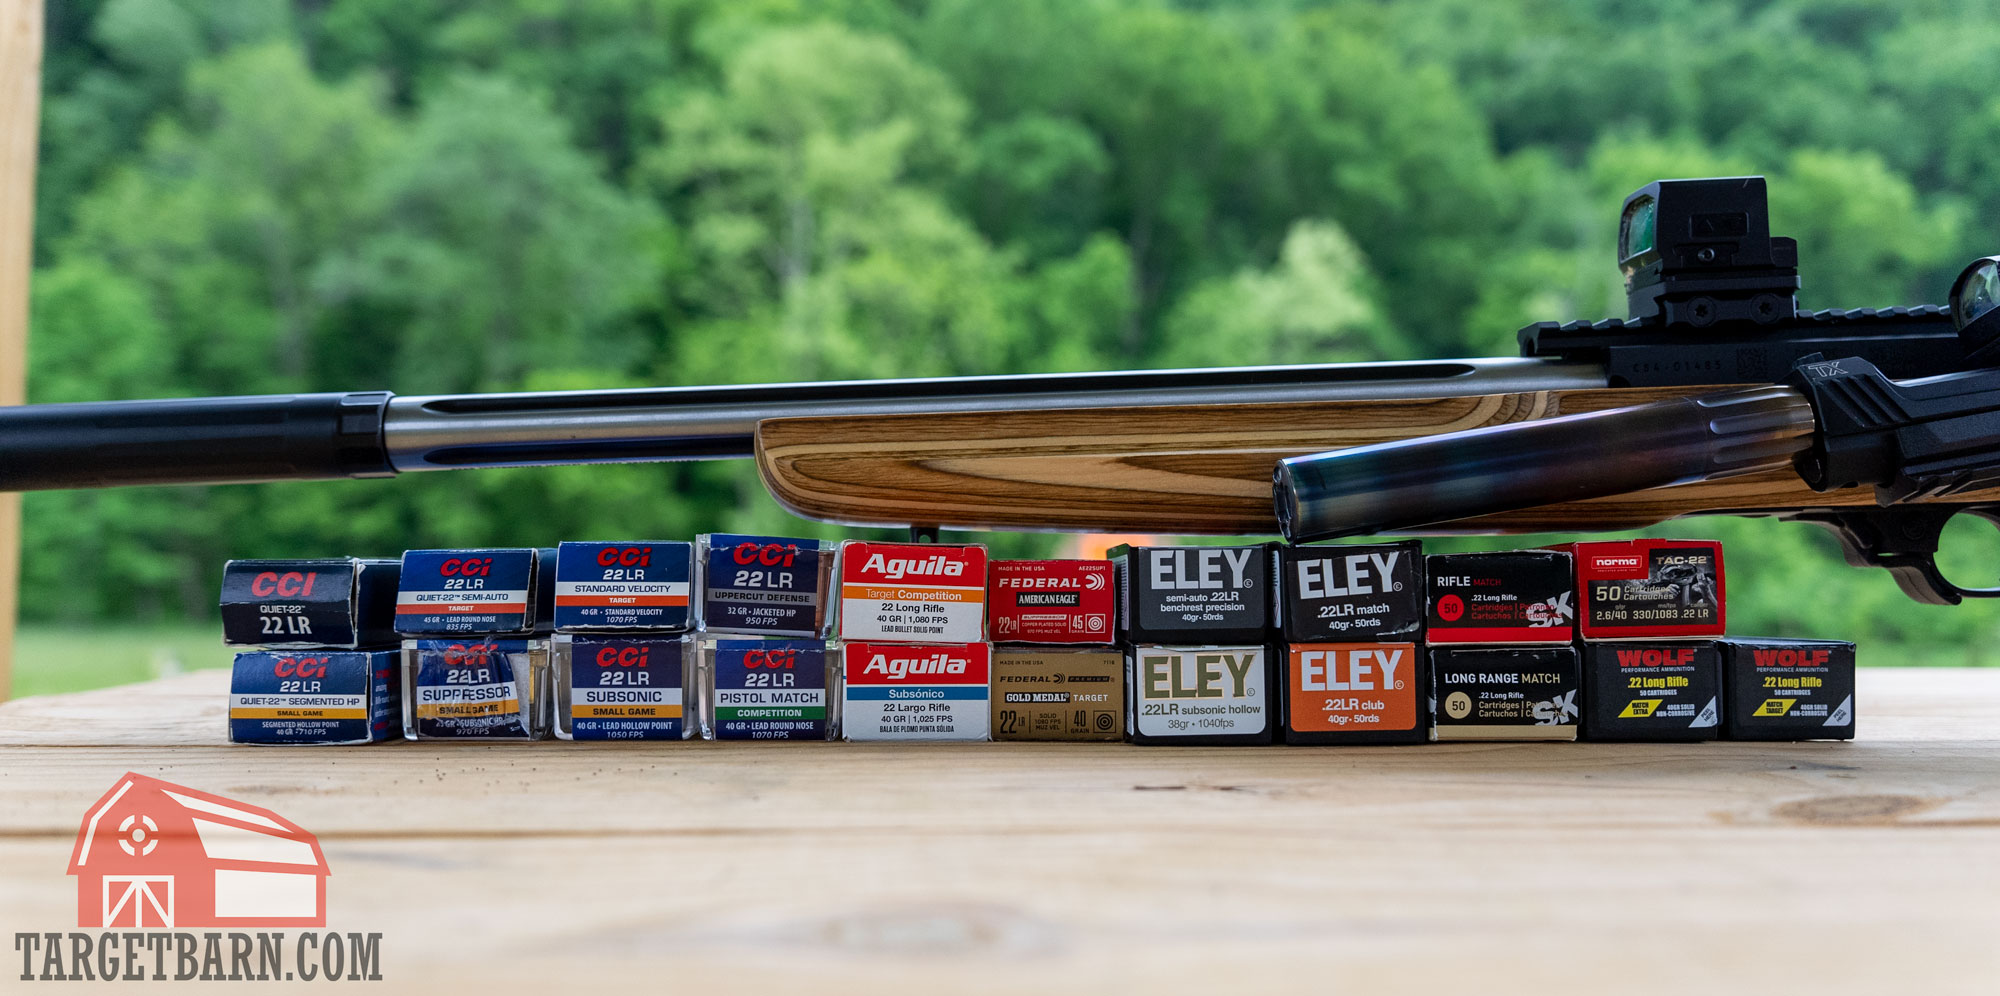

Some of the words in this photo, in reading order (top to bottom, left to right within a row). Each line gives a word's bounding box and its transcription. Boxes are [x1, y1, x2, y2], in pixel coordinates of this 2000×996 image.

[861, 554, 964, 579] Aguila
[603, 569, 624, 580] 22
[626, 570, 644, 580] LR
[734, 570, 764, 587] 22
[767, 572, 793, 589] LR
[252, 572, 317, 597] CCI
[444, 579, 464, 590] 22
[466, 579, 483, 589] LR
[999, 578, 1081, 588] FEDERAL
[1437, 576, 1471, 587] RIFLE
[575, 585, 625, 593] STANDARD
[1596, 586, 1621, 601] 50
[715, 592, 764, 601] UPPERCUT
[767, 594, 810, 602] DEFENSE
[866, 589, 895, 600] Target
[898, 590, 962, 601] Competition
[1019, 595, 1056, 604] AMERICAN
[1056, 595, 1076, 604] EAGLE
[1166, 594, 1208, 602] semi-auto
[1210, 591, 1239, 601] .22LR
[882, 603, 893, 611] 22
[896, 604, 920, 614] Long
[923, 604, 945, 613] Rifle
[1161, 604, 1203, 612] benchrest
[1206, 604, 1245, 614] precision
[1318, 604, 1354, 618] .22LR
[1357, 603, 1390, 614] match
[1444, 603, 1458, 613] 50
[909, 616, 930, 624] 1,080
[932, 616, 948, 624] FPS
[1597, 610, 1627, 620] 2.6/40
[1633, 610, 1678, 619] 330/1083
[1681, 610, 1695, 618] .22
[1698, 609, 1709, 618] LR
[260, 617, 285, 634] 22
[288, 616, 312, 634] LR
[745, 617, 761, 625] 950
[1073, 615, 1083, 629] 45
[1329, 621, 1350, 631] 40gr
[1355, 618, 1381, 627] 50rds
[1617, 649, 1695, 667] WOLF
[1753, 650, 1829, 667] WOLF
[863, 654, 967, 679] Aguila
[468, 669, 490, 684] LR
[600, 672, 624, 685] 22
[628, 672, 650, 685] LR
[745, 673, 770, 687] 22
[773, 673, 795, 687] LR
[1445, 674, 1476, 684] LONG
[1479, 674, 1519, 684] RANGE
[1522, 674, 1560, 684] MATCH
[280, 681, 300, 692] 22
[303, 681, 321, 692] LR
[1628, 677, 1642, 688] .22
[1643, 677, 1665, 688] Long
[1667, 677, 1689, 687] Rifle
[1763, 677, 1776, 687] .22
[1778, 677, 1799, 688] Long
[1801, 677, 1822, 687] Rifle
[587, 692, 662, 703] SUBSONIC
[721, 693, 766, 703] PISTOL
[772, 693, 819, 703] MATCH
[889, 689, 944, 698] Subsónico
[1007, 694, 1031, 702] GOLD
[1033, 694, 1067, 702] MEDAL
[884, 704, 895, 712] 22
[898, 704, 926, 713] Largo
[929, 704, 950, 712] Rifle
[1142, 704, 1179, 715] .22LR
[1182, 706, 1226, 715] subsonic
[1229, 705, 1261, 714] hollow
[1322, 698, 1359, 710] .22LR
[1362, 701, 1385, 710] club
[1452, 701, 1466, 711] 50
[1479, 701, 1520, 710] Cartridges
[593, 708, 625, 716] SMALL
[628, 708, 656, 716] GAME
[913, 716, 934, 724] 1,025
[1000, 711, 1016, 734] 22
[1074, 711, 1086, 727] 40
[1168, 720, 1189, 730] 38gr
[1198, 718, 1234, 729] 1040fps
[1328, 715, 1349, 725] 40gr
[1354, 714, 1380, 723] 50rds
[577, 722, 585, 730] 40
[587, 722, 596, 730] GR
[603, 722, 620, 730] LEAD
[621, 722, 650, 730] HOLLOW
[652, 722, 672, 730] POINT
[726, 722, 735, 730] 40
[736, 722, 746, 730] GR
[752, 722, 768, 730] LEAD
[770, 722, 794, 730] ROUND
[796, 722, 814, 730] NOSE
